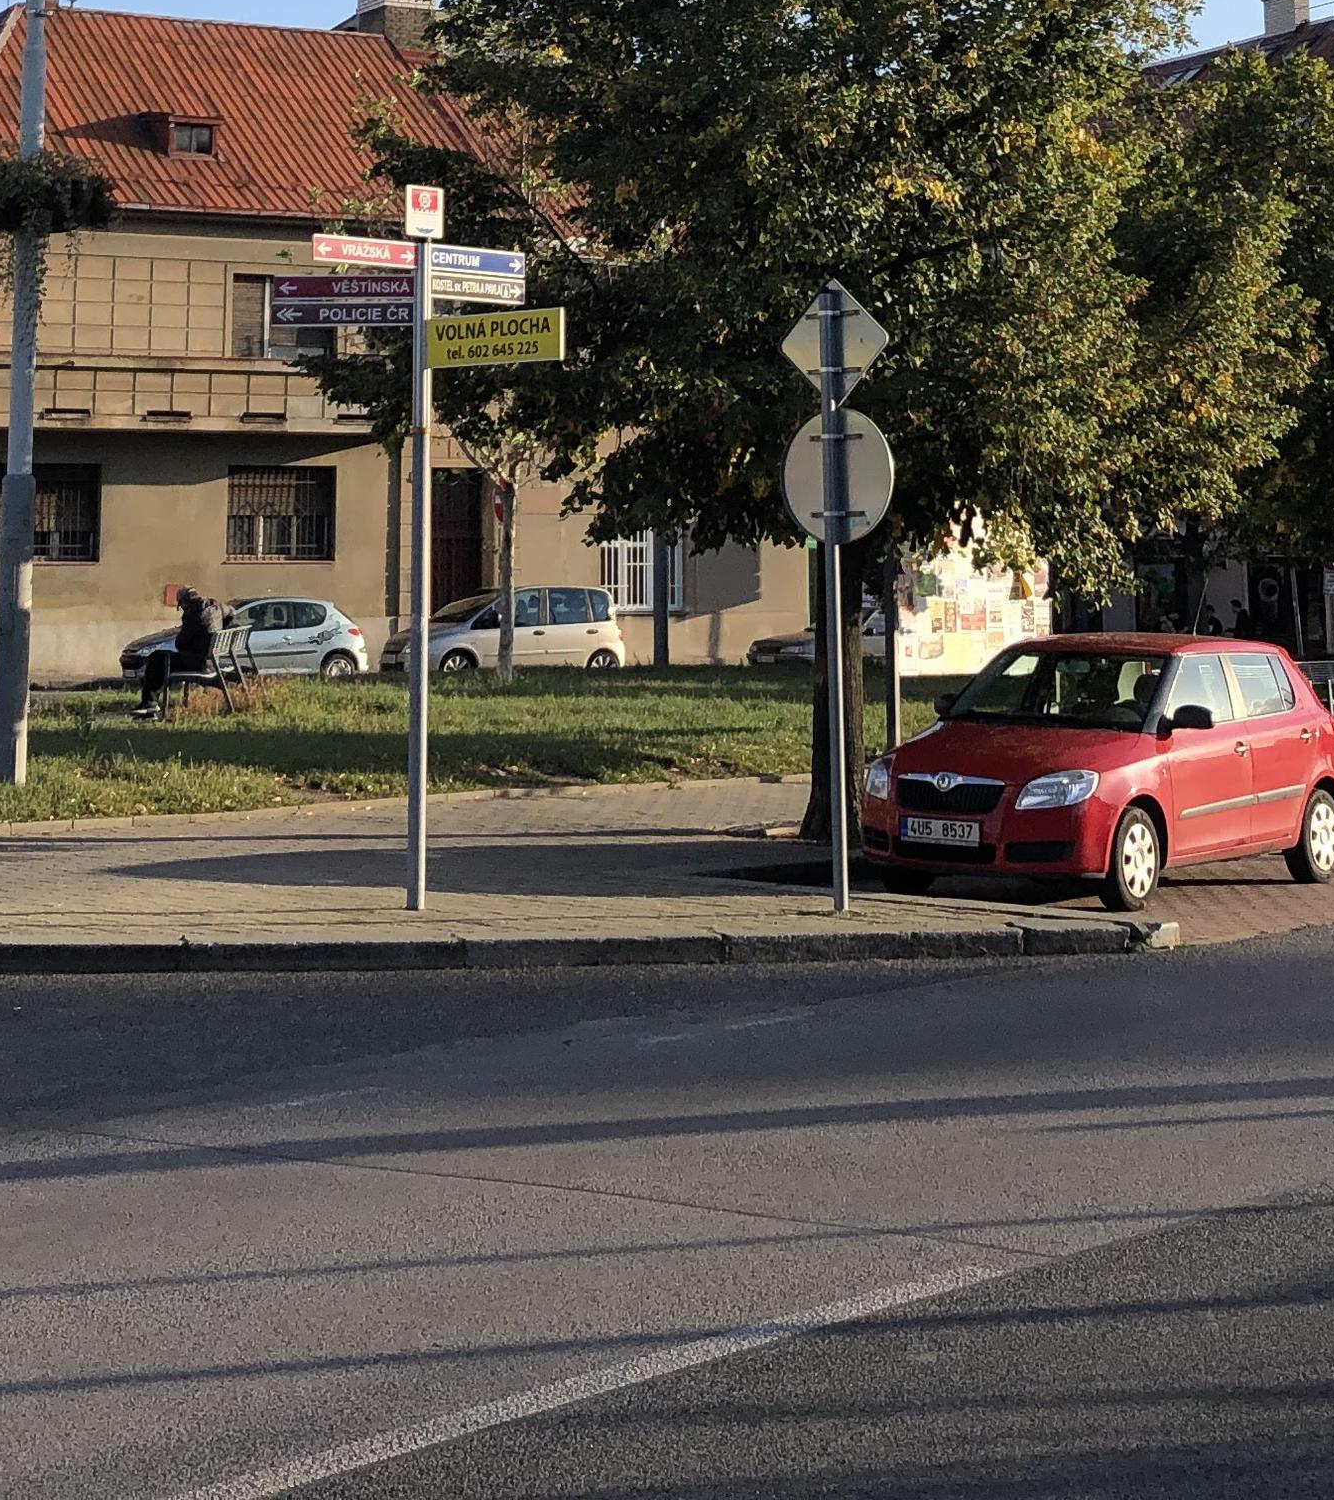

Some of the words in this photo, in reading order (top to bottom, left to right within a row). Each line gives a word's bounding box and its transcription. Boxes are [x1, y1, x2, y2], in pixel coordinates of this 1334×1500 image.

[341, 243, 391, 260] VRÁŽSKÁ
[432, 252, 480, 267] CENTRUM
[332, 279, 410, 293] VĚŠTÍNSKÁ
[319, 308, 382, 321] POLICIE
[386, 305, 409, 320] ČR
[436, 318, 486, 341] VOLNÁ
[490, 316, 551, 337] PLOCHA
[447, 345, 465, 359] tel.
[468, 345, 489, 358] 602
[492, 343, 514, 357] 645
[517, 341, 539, 354] 225
[910, 819, 932, 836] 4U5
[942, 822, 973, 839] 8537
